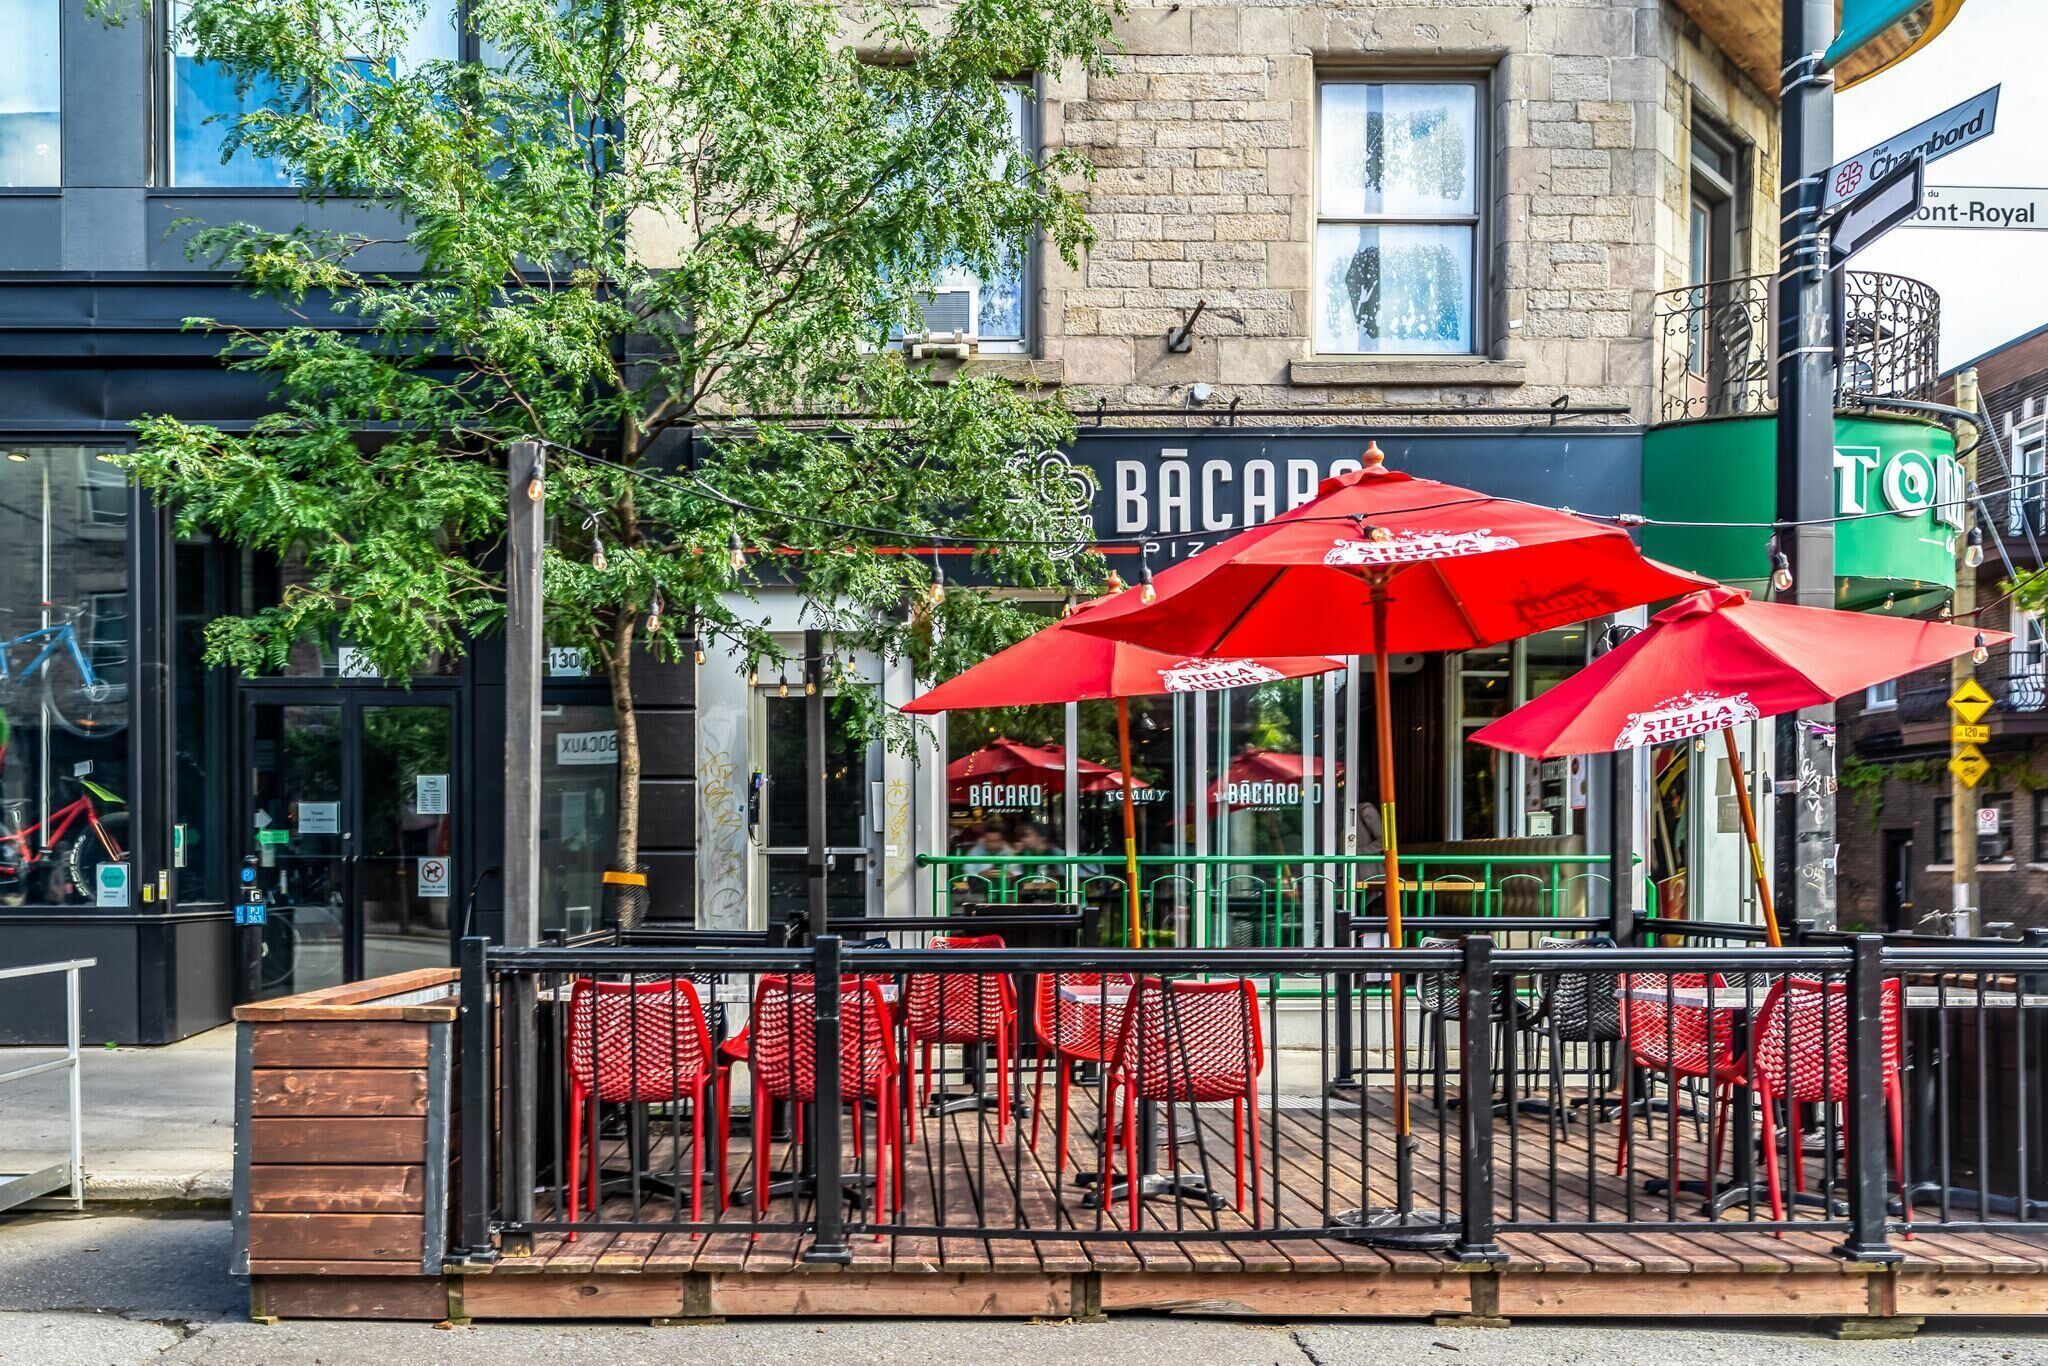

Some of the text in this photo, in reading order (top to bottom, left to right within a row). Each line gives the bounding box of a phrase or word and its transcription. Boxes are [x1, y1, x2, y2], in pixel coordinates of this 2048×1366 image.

[1869, 108, 1984, 181] Chambord
[1872, 146, 1888, 158] Rue
[1928, 190, 1939, 198] du
[1909, 201, 2035, 227] ont-Royal
[1116, 448, 1364, 533] BĀCAR
[1143, 541, 1223, 558] PIZ
[1357, 538, 1477, 555] STELLA
[550, 652, 587, 669] 130
[1178, 668, 1252, 683] STELLA
[1189, 675, 1263, 691] ARTOIS
[1643, 706, 1733, 732] STELLA
[1642, 716, 1733, 745] ARTOIS
[969, 781, 1042, 807] BĀCARO
[250, 906, 260, 914] PJ
